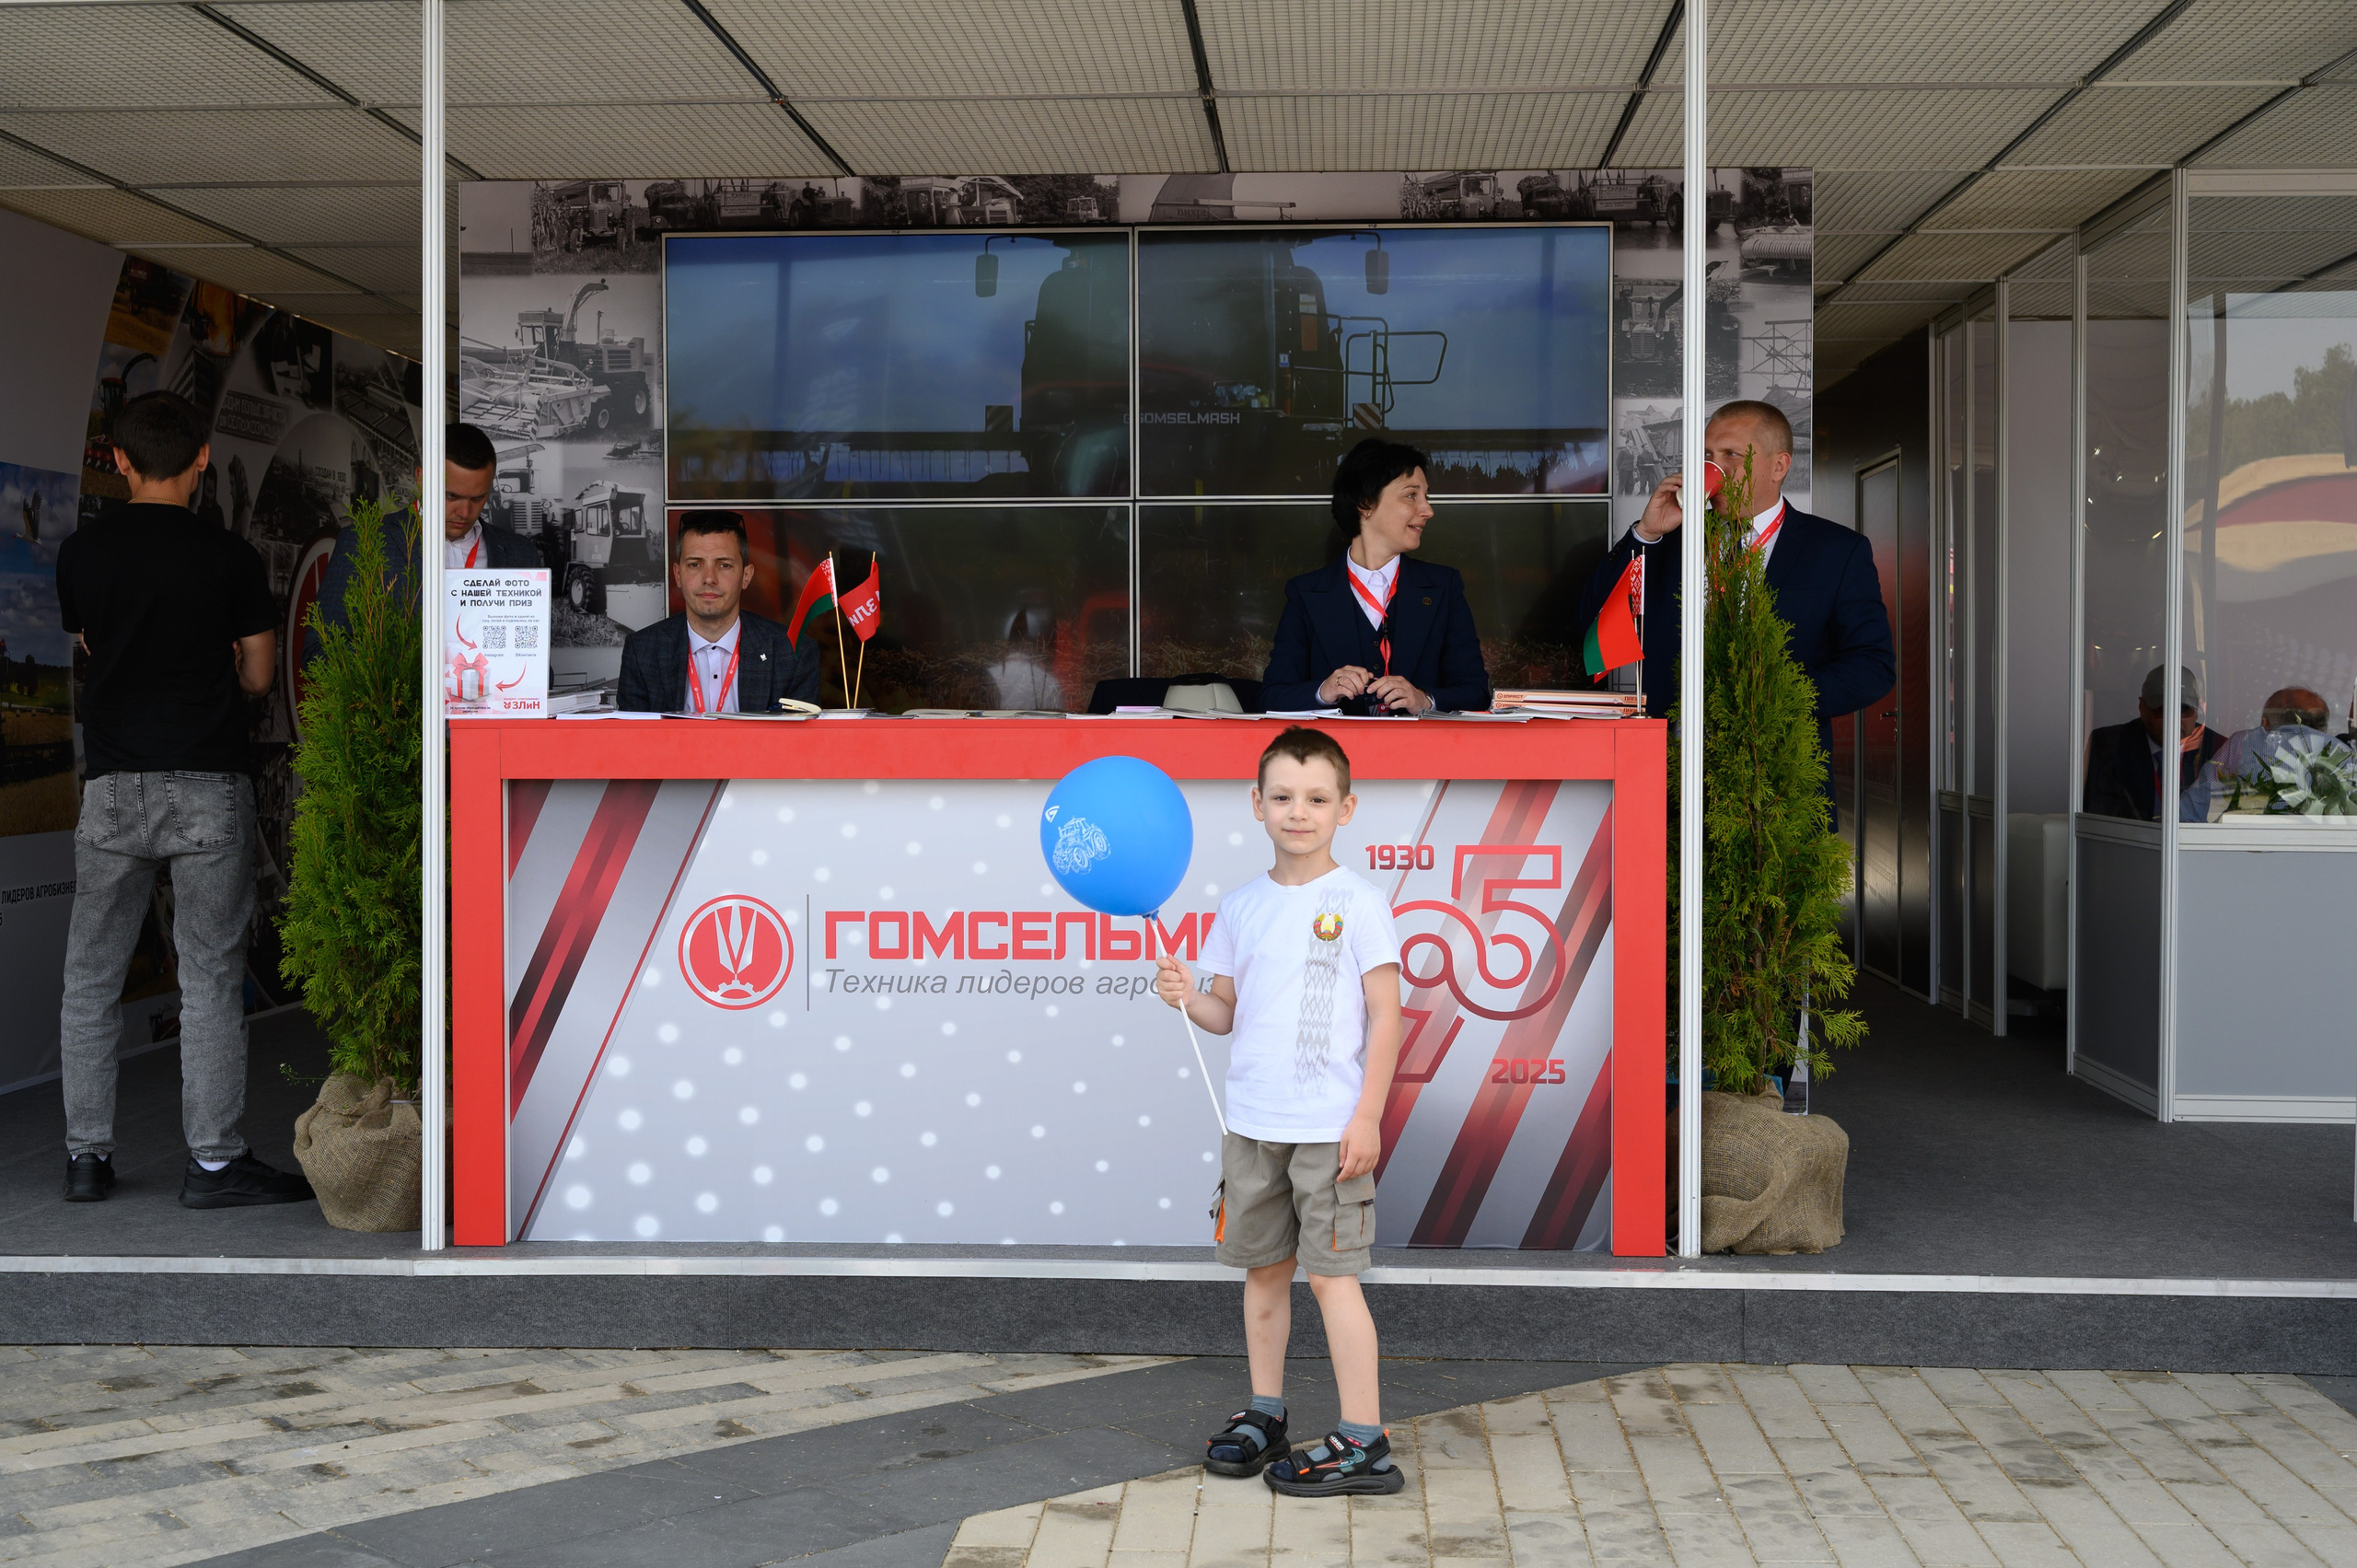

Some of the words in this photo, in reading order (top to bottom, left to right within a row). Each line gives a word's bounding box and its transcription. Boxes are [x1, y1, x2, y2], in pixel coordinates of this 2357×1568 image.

[461, 587, 492, 597] НАШЕЙ
[496, 587, 541, 597] ТЕХНИКОЙ
[463, 578, 501, 587] СДЕЛАЙ
[1365, 844, 1434, 870] 1930
[1, 889, 35, 904] ЛИДЕРОВ
[825, 969, 947, 993] Техника
[955, 970, 1086, 1001] лидеров
[1492, 1059, 1566, 1084] 2025
